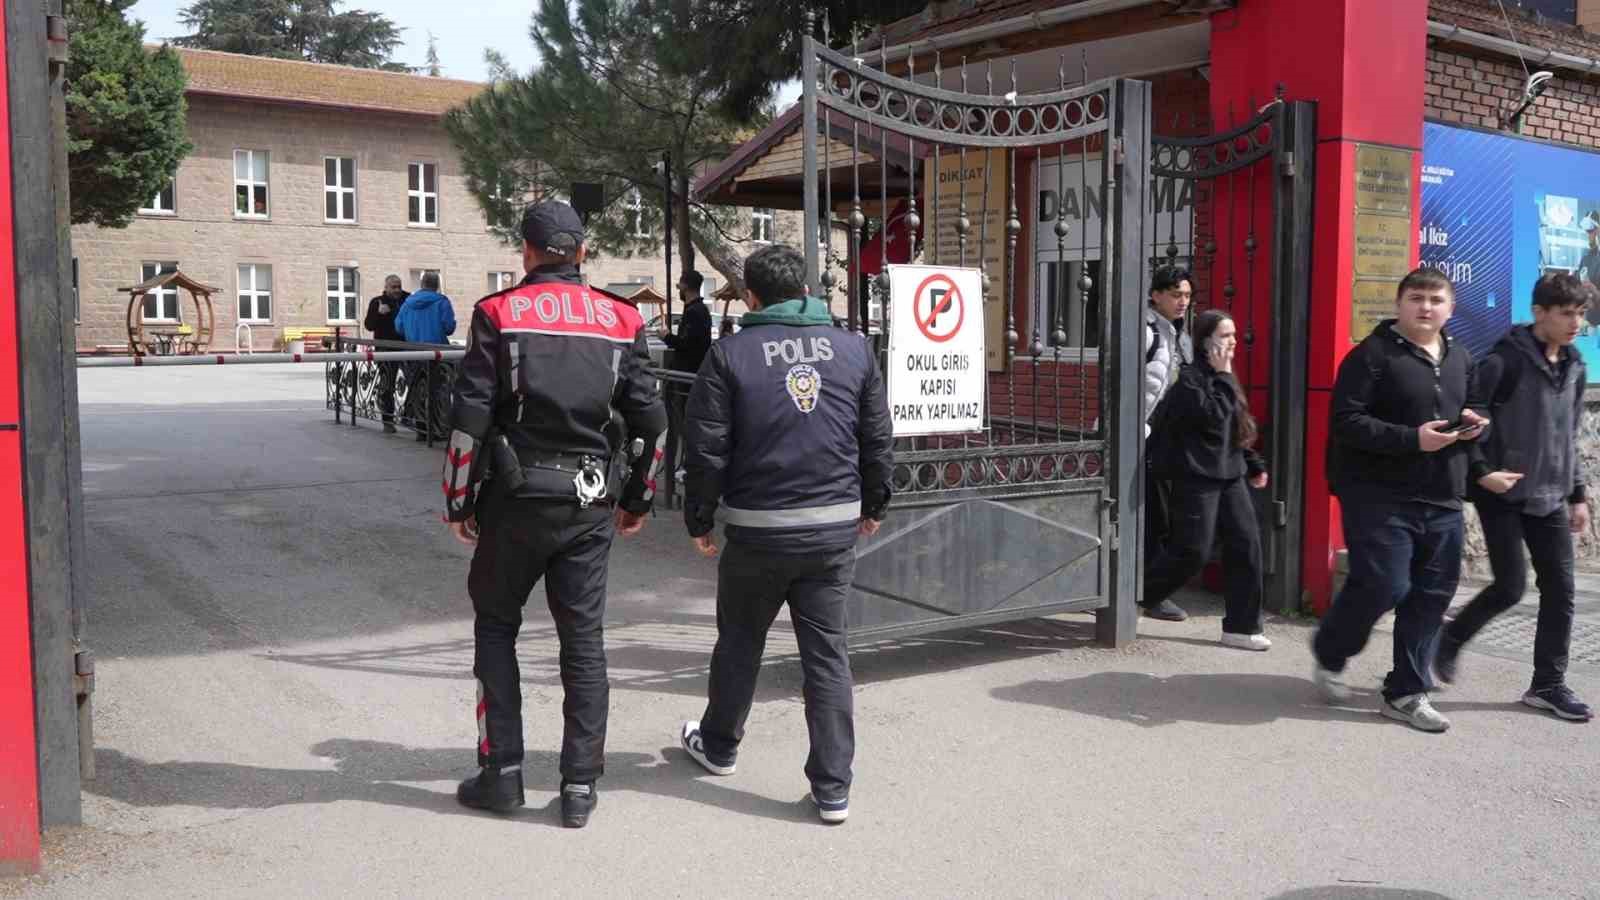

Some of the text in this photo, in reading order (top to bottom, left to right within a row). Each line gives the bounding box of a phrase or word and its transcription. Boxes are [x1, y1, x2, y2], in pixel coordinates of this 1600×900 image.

[509, 291, 617, 328] POLİS
[907, 354, 938, 371] OKUL
[920, 379, 956, 396] KAPISI
[893, 402, 979, 421] PARK YAPILMAZ
